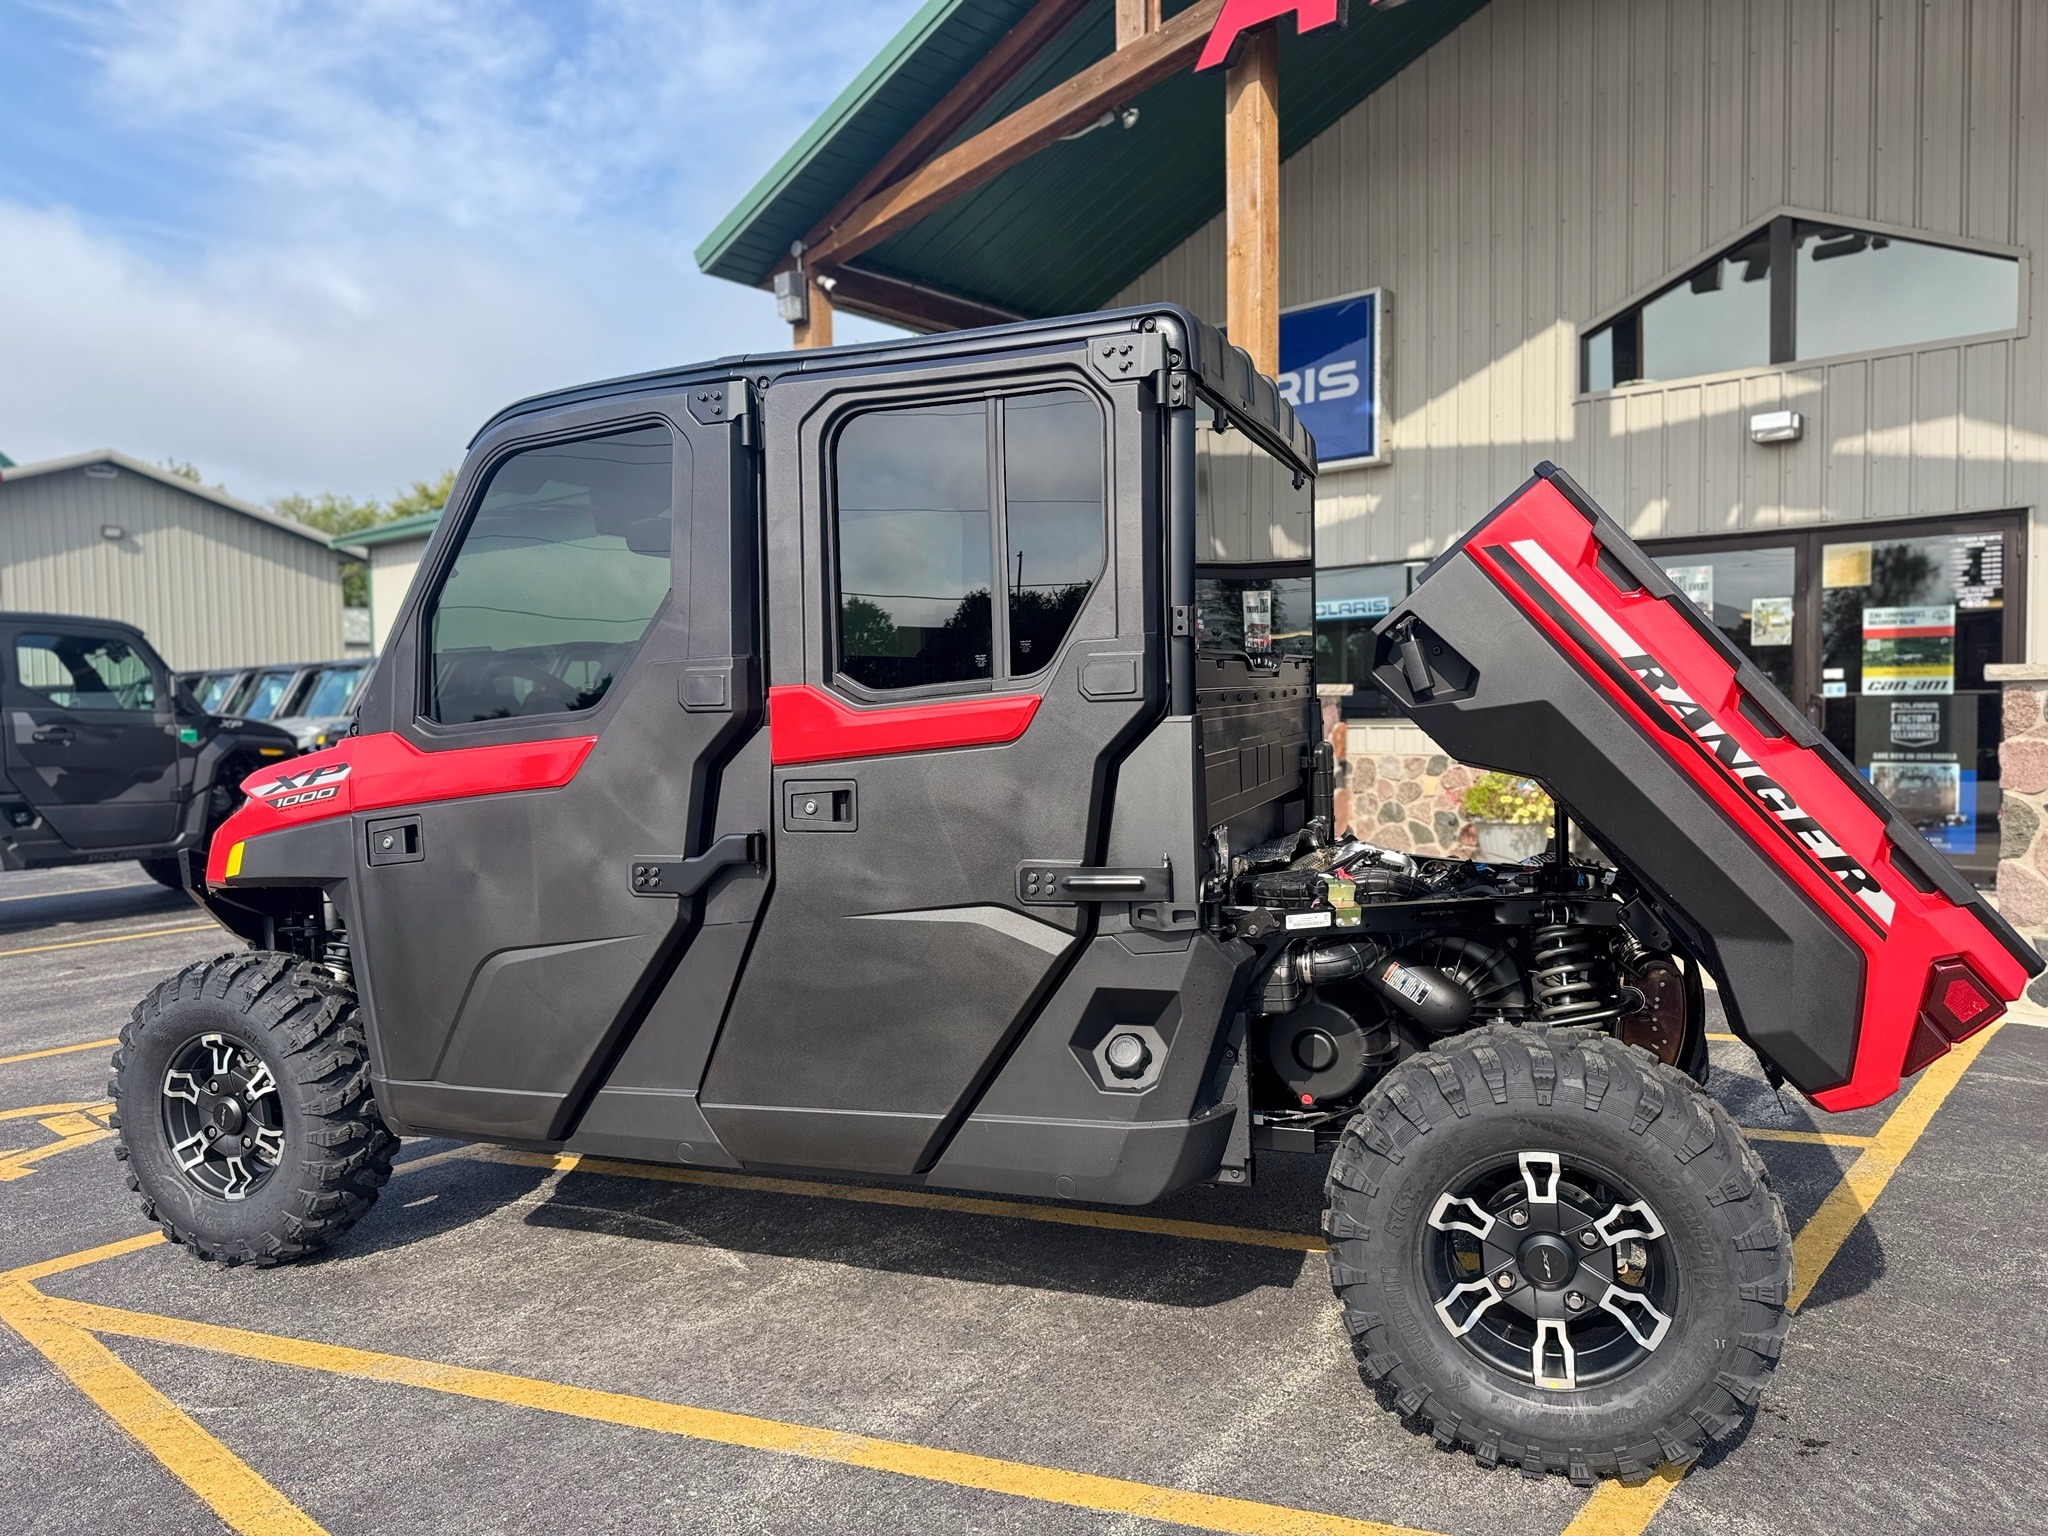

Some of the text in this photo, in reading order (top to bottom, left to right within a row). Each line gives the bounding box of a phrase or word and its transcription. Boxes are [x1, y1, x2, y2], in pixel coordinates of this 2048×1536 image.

[1867, 680, 1948, 691] can-am
[219, 719, 244, 729] XP
[1897, 714, 1933, 723] FACTORY
[1894, 731, 1935, 740] CLEARANCE
[262, 763, 350, 796] XP
[1619, 654, 1882, 895] RANGER
[275, 787, 336, 808] 1000
